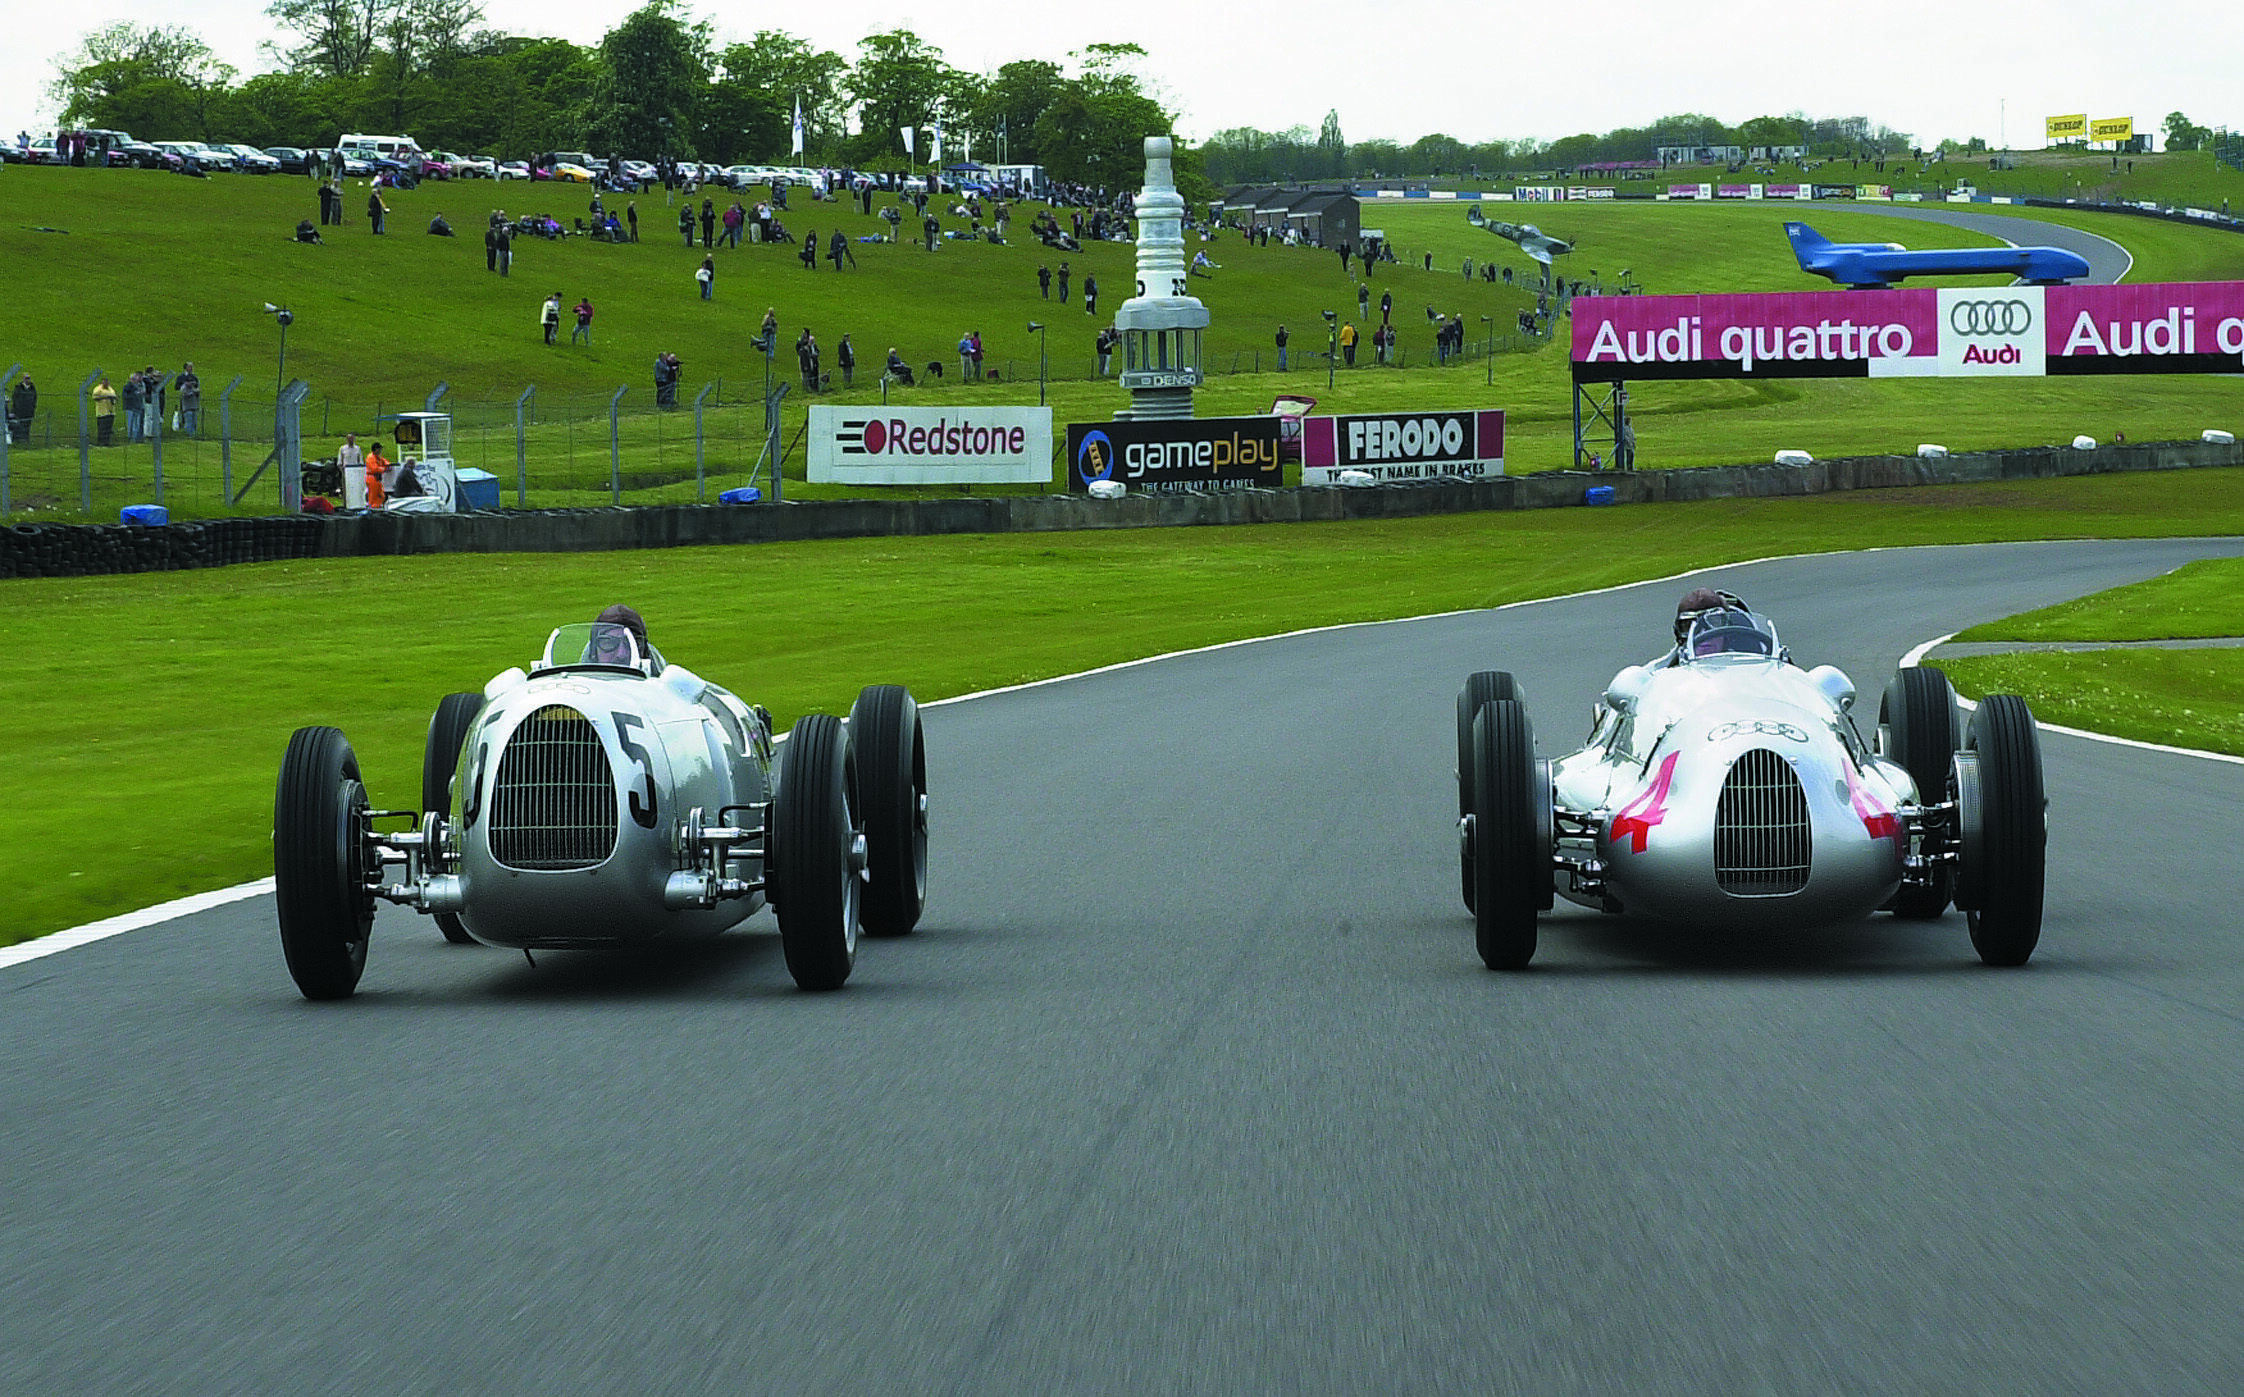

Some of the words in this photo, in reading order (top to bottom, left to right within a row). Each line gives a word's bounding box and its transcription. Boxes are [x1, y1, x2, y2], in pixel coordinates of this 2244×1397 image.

[1518, 187, 1549, 202] Mobil
[1585, 315, 1702, 363] Audi
[1720, 318, 1913, 372] quattro
[2062, 307, 2195, 357] Audi
[1962, 343, 2021, 364] Audi
[888, 418, 1025, 456] Redstone
[1125, 430, 1279, 478] gameplay
[1348, 417, 1464, 461] FERODO
[1208, 479, 1220, 491] TO
[1387, 465, 1421, 478] NAME
[1425, 464, 1438, 477] IN
[610, 710, 658, 829] 5
